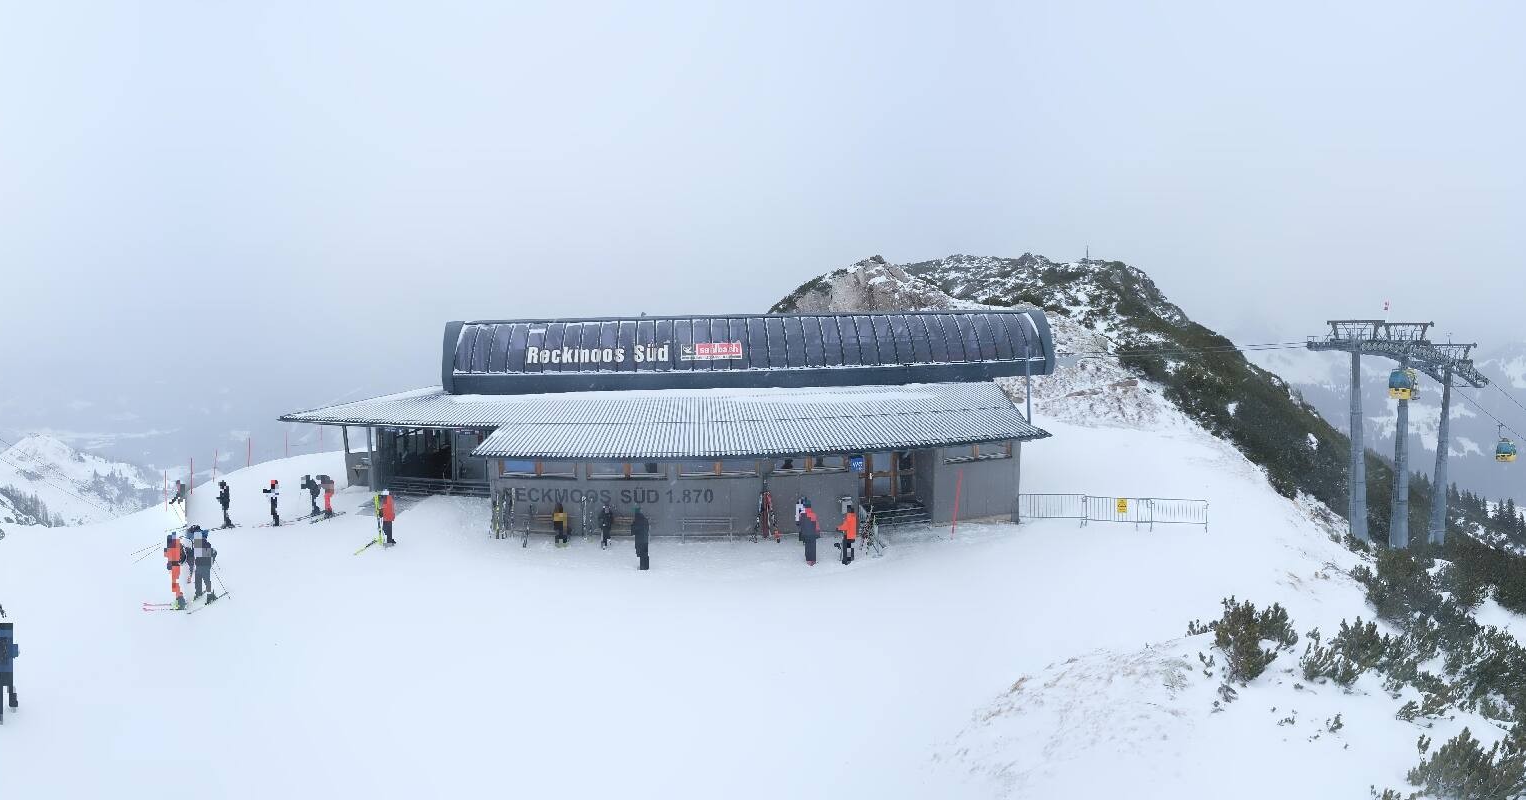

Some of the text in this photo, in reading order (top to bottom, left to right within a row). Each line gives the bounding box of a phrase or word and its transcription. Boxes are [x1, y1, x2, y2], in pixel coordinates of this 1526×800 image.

[526, 342, 669, 364] Reckmoos Süd
[620, 487, 660, 504] SÜD
[666, 488, 714, 504] 1.870
